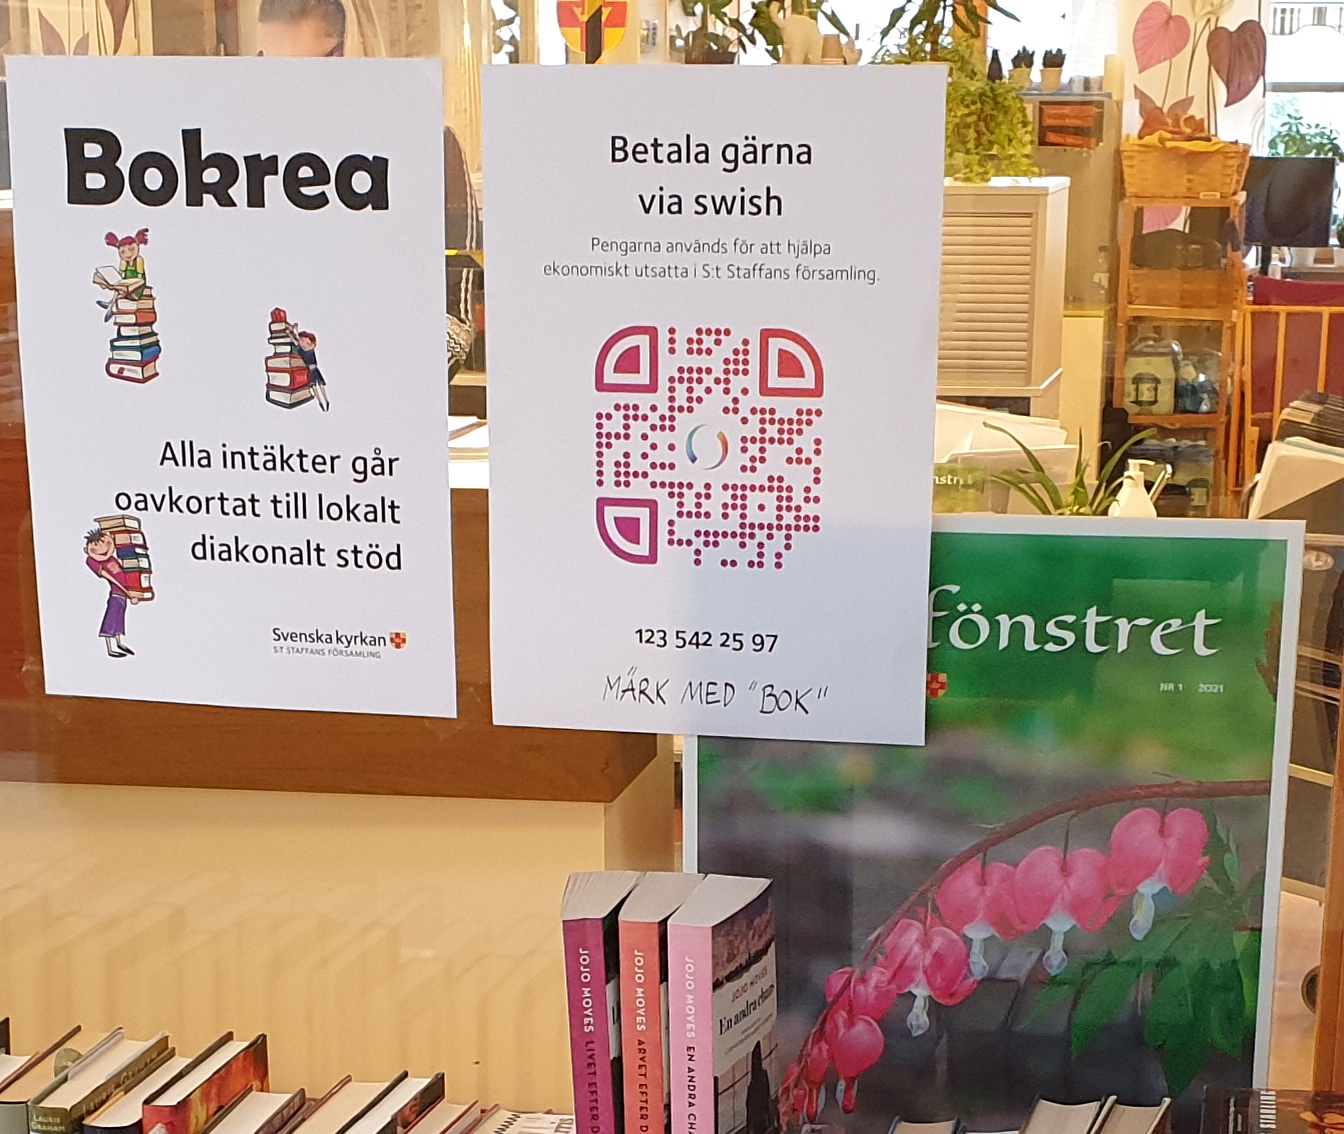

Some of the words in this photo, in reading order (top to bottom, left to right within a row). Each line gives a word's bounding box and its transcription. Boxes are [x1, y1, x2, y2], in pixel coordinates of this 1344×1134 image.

[63, 127, 390, 211] Bokrea
[610, 134, 710, 165] Betala
[720, 134, 813, 173] gärna
[638, 186, 683, 216] via
[694, 186, 783, 216] swish
[591, 238, 662, 257] Pengarna
[665, 237, 728, 255] används
[733, 238, 755, 255] för
[760, 240, 782, 255] att
[787, 239, 831, 258] hjälpa
[543, 261, 630, 278] ekonomiskt
[634, 264, 689, 279] utsatta
[726, 263, 790, 281] Staffans
[795, 264, 881, 285] församling.
[159, 440, 212, 468] Alla
[221, 443, 341, 474] intäkter
[351, 448, 399, 483] går
[114, 486, 261, 518] oavkortat
[270, 492, 307, 519] till
[318, 494, 401, 524] lokalt
[190, 534, 326, 567] diakonalt
[336, 544, 402, 570] stöd
[272, 628, 333, 645] Svenska
[335, 630, 387, 650] kyrkan
[927, 584, 1222, 657] fönstret
[286, 646, 325, 657] STAFFANS
[328, 647, 381, 659] FÖRSAMLING
[635, 627, 668, 650] 123
[675, 628, 714, 651] 542
[719, 631, 745, 651] 25
[751, 632, 779, 653] 97
[680, 678, 736, 708] MED
[579, 948, 590, 983] JOJO
[634, 950, 645, 983] JOJO
[685, 957, 695, 990] JOJO
[582, 987, 594, 1033] MOYES
[635, 987, 646, 1032] MOYES
[685, 994, 696, 1038] MOYES
[585, 1040, 597, 1078] LIVET
[637, 1040, 647, 1080] ARVET
[686, 1046, 696, 1062] EN
[588, 1082, 599, 1122] EFTER
[638, 1083, 649, 1122] EFTER
[686, 1066, 697, 1108] ANDRA
